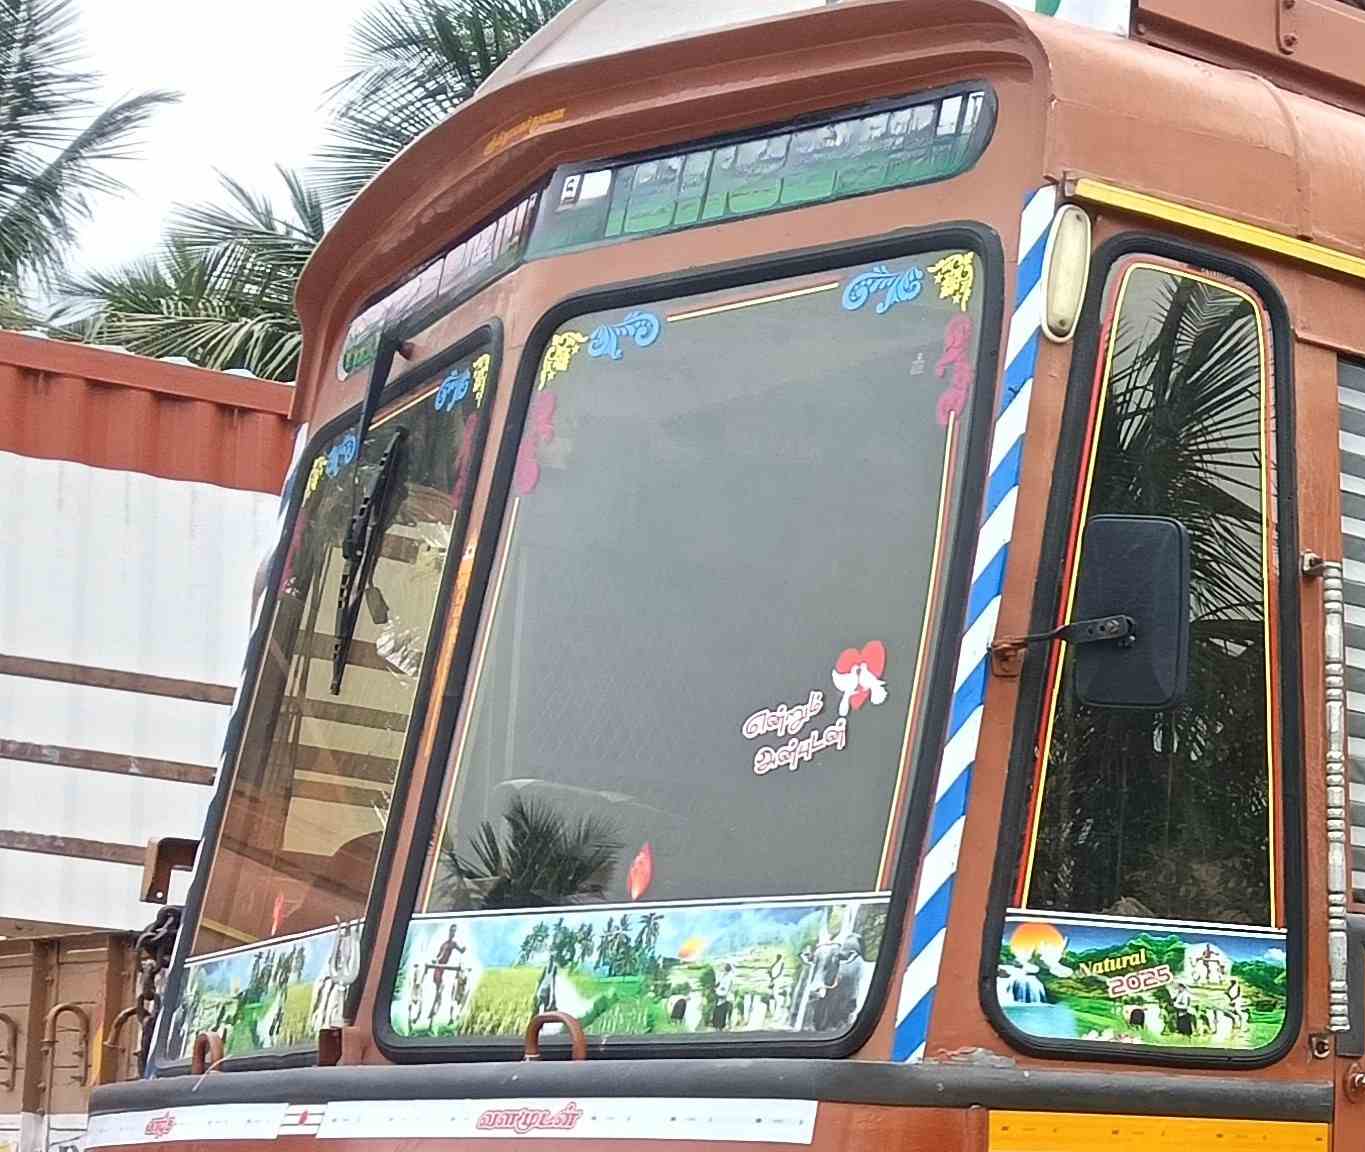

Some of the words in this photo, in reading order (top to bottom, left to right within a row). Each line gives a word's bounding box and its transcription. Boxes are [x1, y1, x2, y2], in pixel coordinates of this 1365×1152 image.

[754, 718, 847, 774] அன்புடன்
[1076, 948, 1146, 978] Natural
[1109, 965, 1173, 998] 2025
